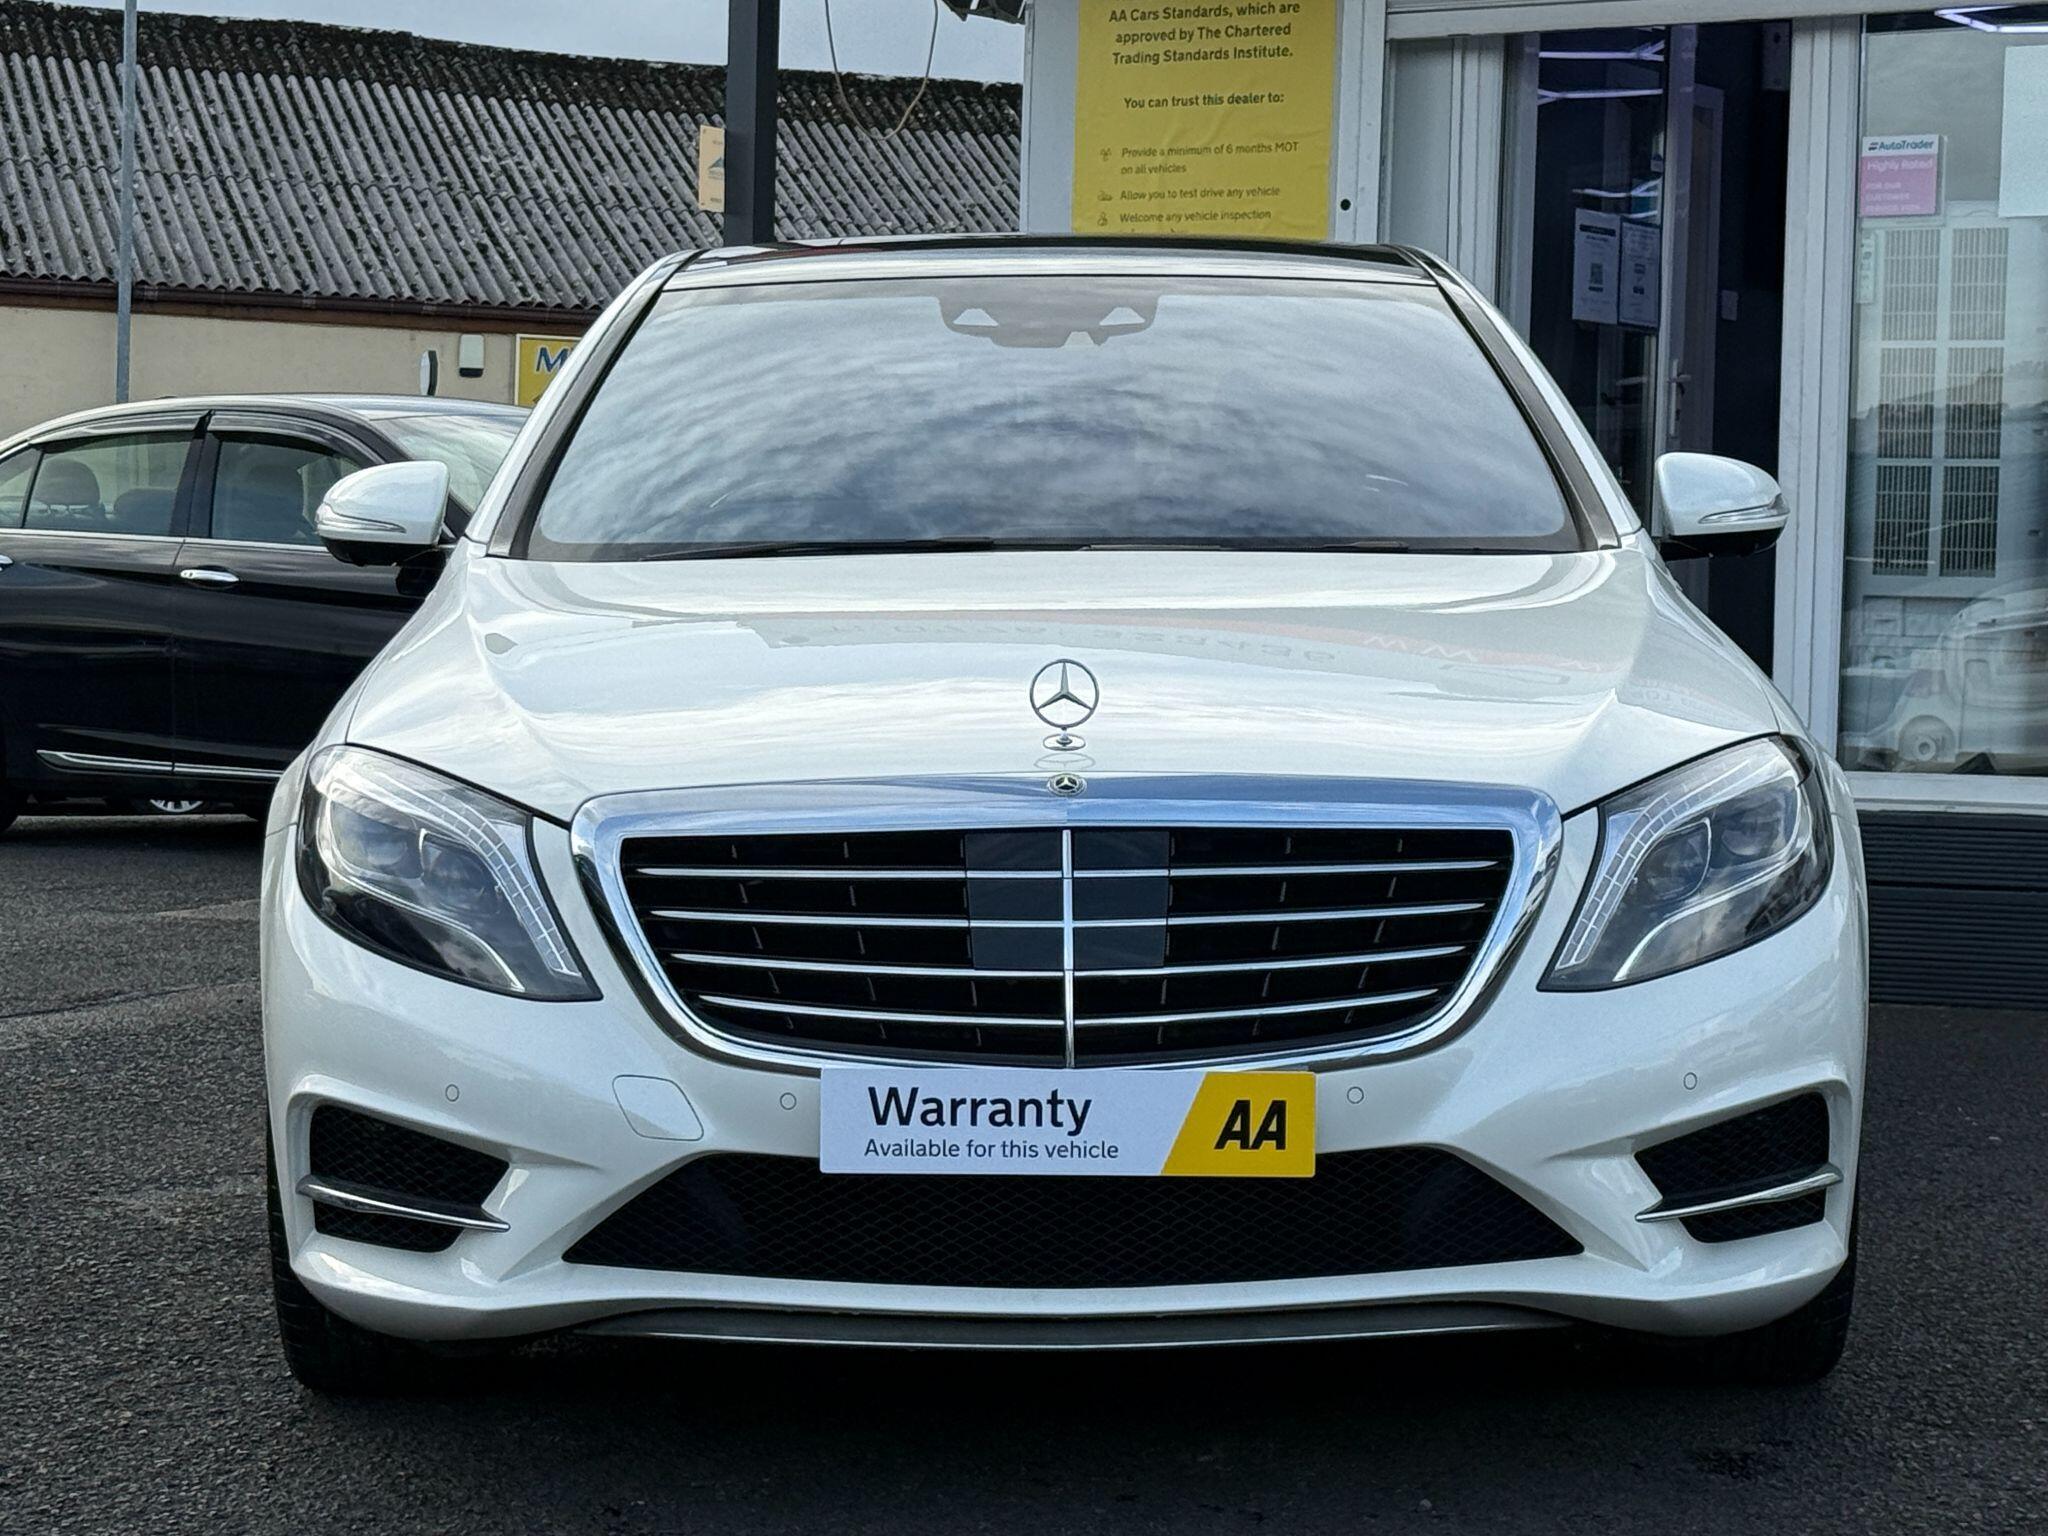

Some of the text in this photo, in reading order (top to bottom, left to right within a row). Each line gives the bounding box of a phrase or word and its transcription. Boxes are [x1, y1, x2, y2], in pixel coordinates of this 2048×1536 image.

[1109, 2, 1300, 22] AA Cars Standards, which are
[1115, 23, 1292, 45] approved by The Chartered
[1113, 45, 1293, 65] Trading Standards Institute.
[1124, 92, 1285, 109] You can trust this dealer to:
[1121, 147, 1158, 158] Provide
[1167, 144, 1212, 156] minimum
[1214, 143, 1225, 155] of
[1226, 143, 1232, 154] 6
[1235, 142, 1272, 154] months
[1275, 141, 1299, 152] MOT
[1879, 139, 1934, 151] AutoTrader
[1121, 162, 1187, 174] on all vehicles
[1120, 185, 1281, 202] Allow you to test drive any vehicle
[1120, 209, 1272, 224] Welcome any vehicle inspection
[535, 346, 572, 372] M
[868, 1085, 1287, 1151] Warranty AA
[864, 1138, 1119, 1160] Available for this vehicle
